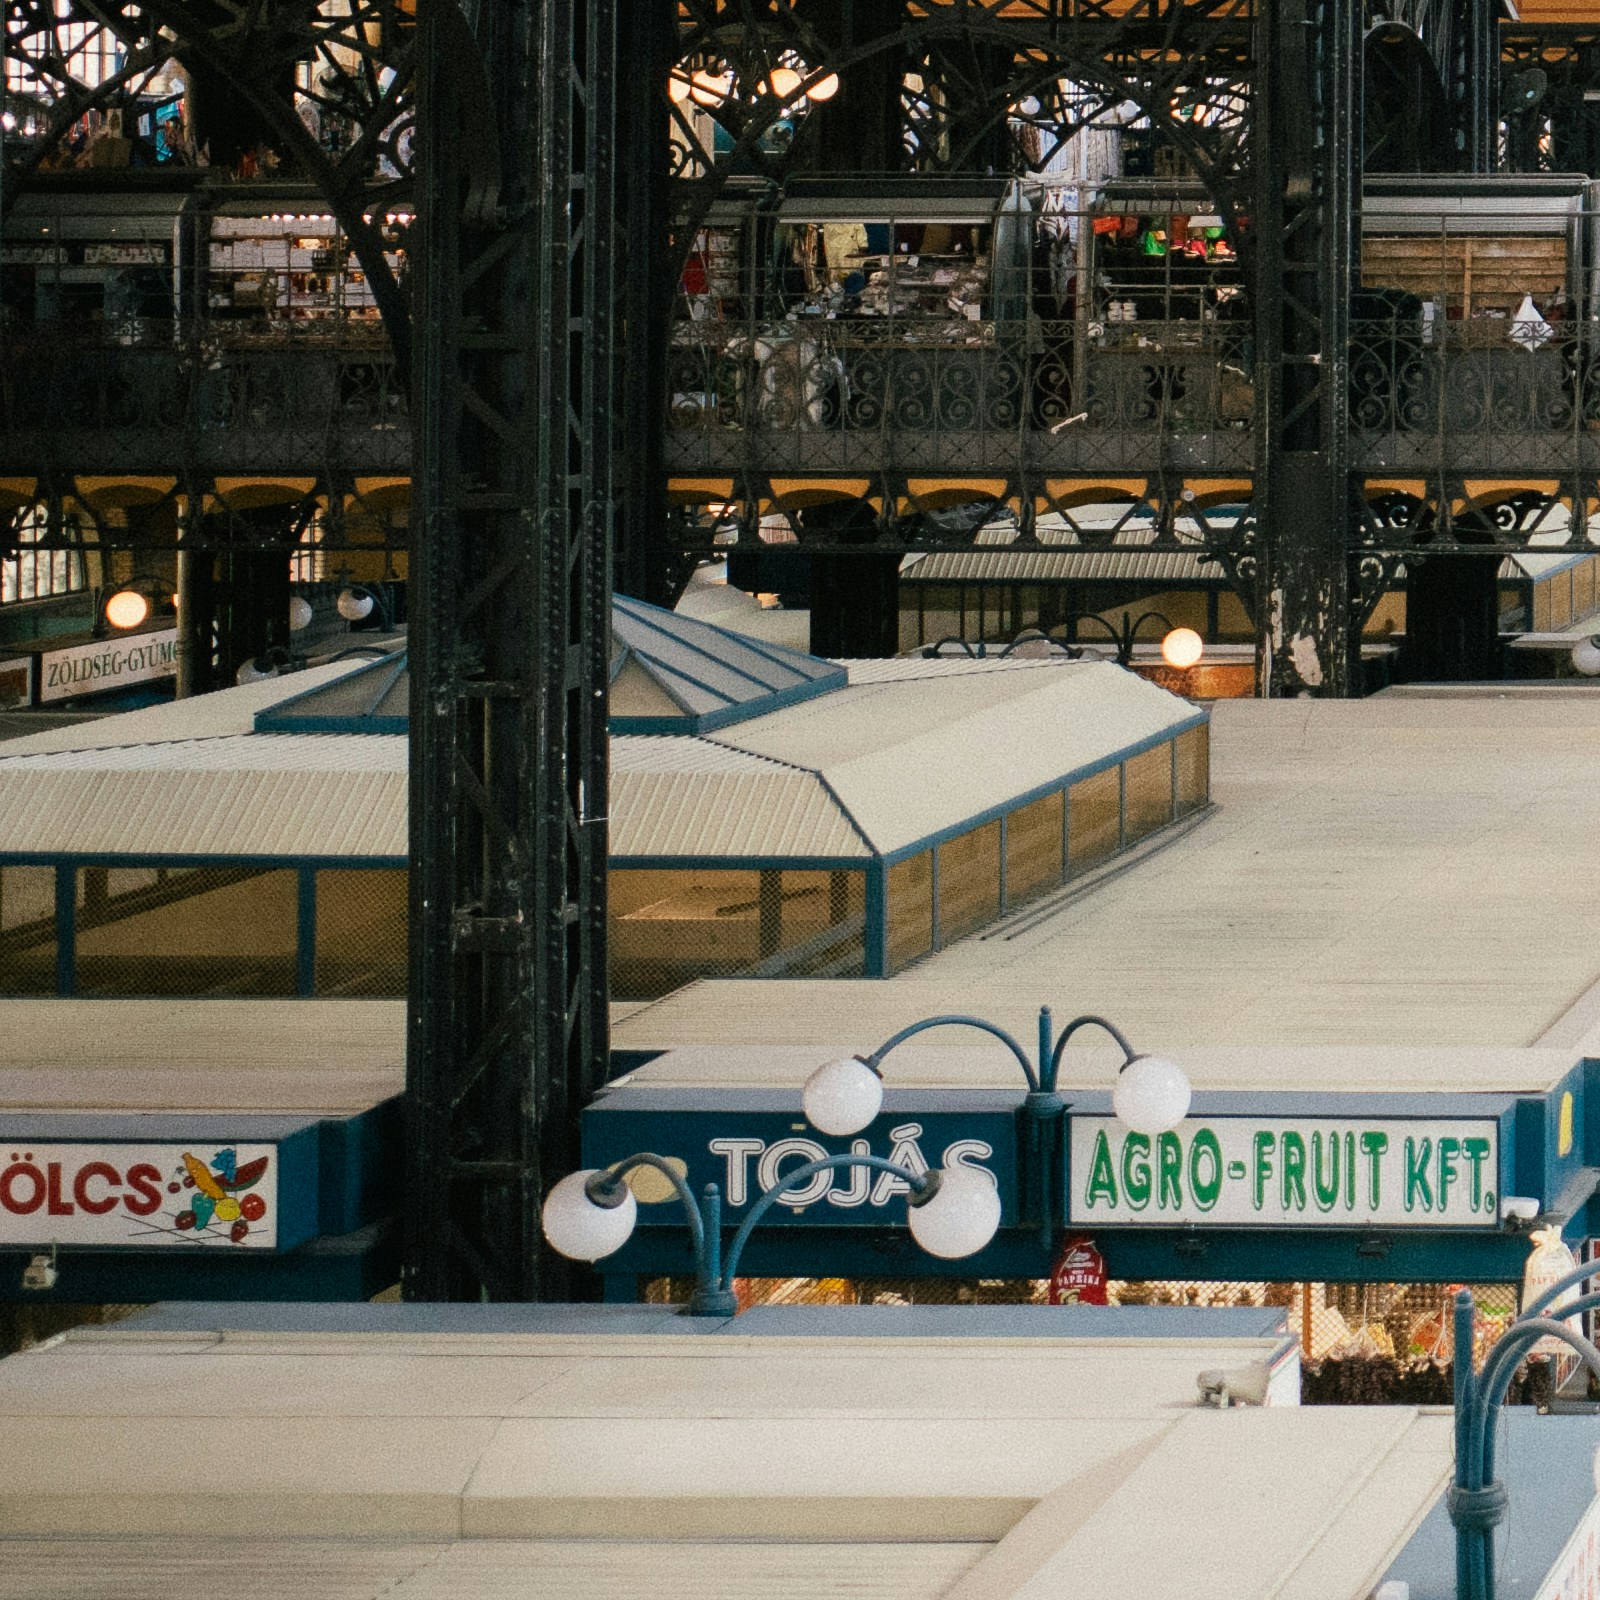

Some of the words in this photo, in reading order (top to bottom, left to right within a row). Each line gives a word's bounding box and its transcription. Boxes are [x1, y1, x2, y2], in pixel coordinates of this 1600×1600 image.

[0, 1151, 163, 1217] ÖLCS
[1084, 1127, 1389, 1213] AGRO-FRUIT
[1403, 1135, 1497, 1214] KFT.
